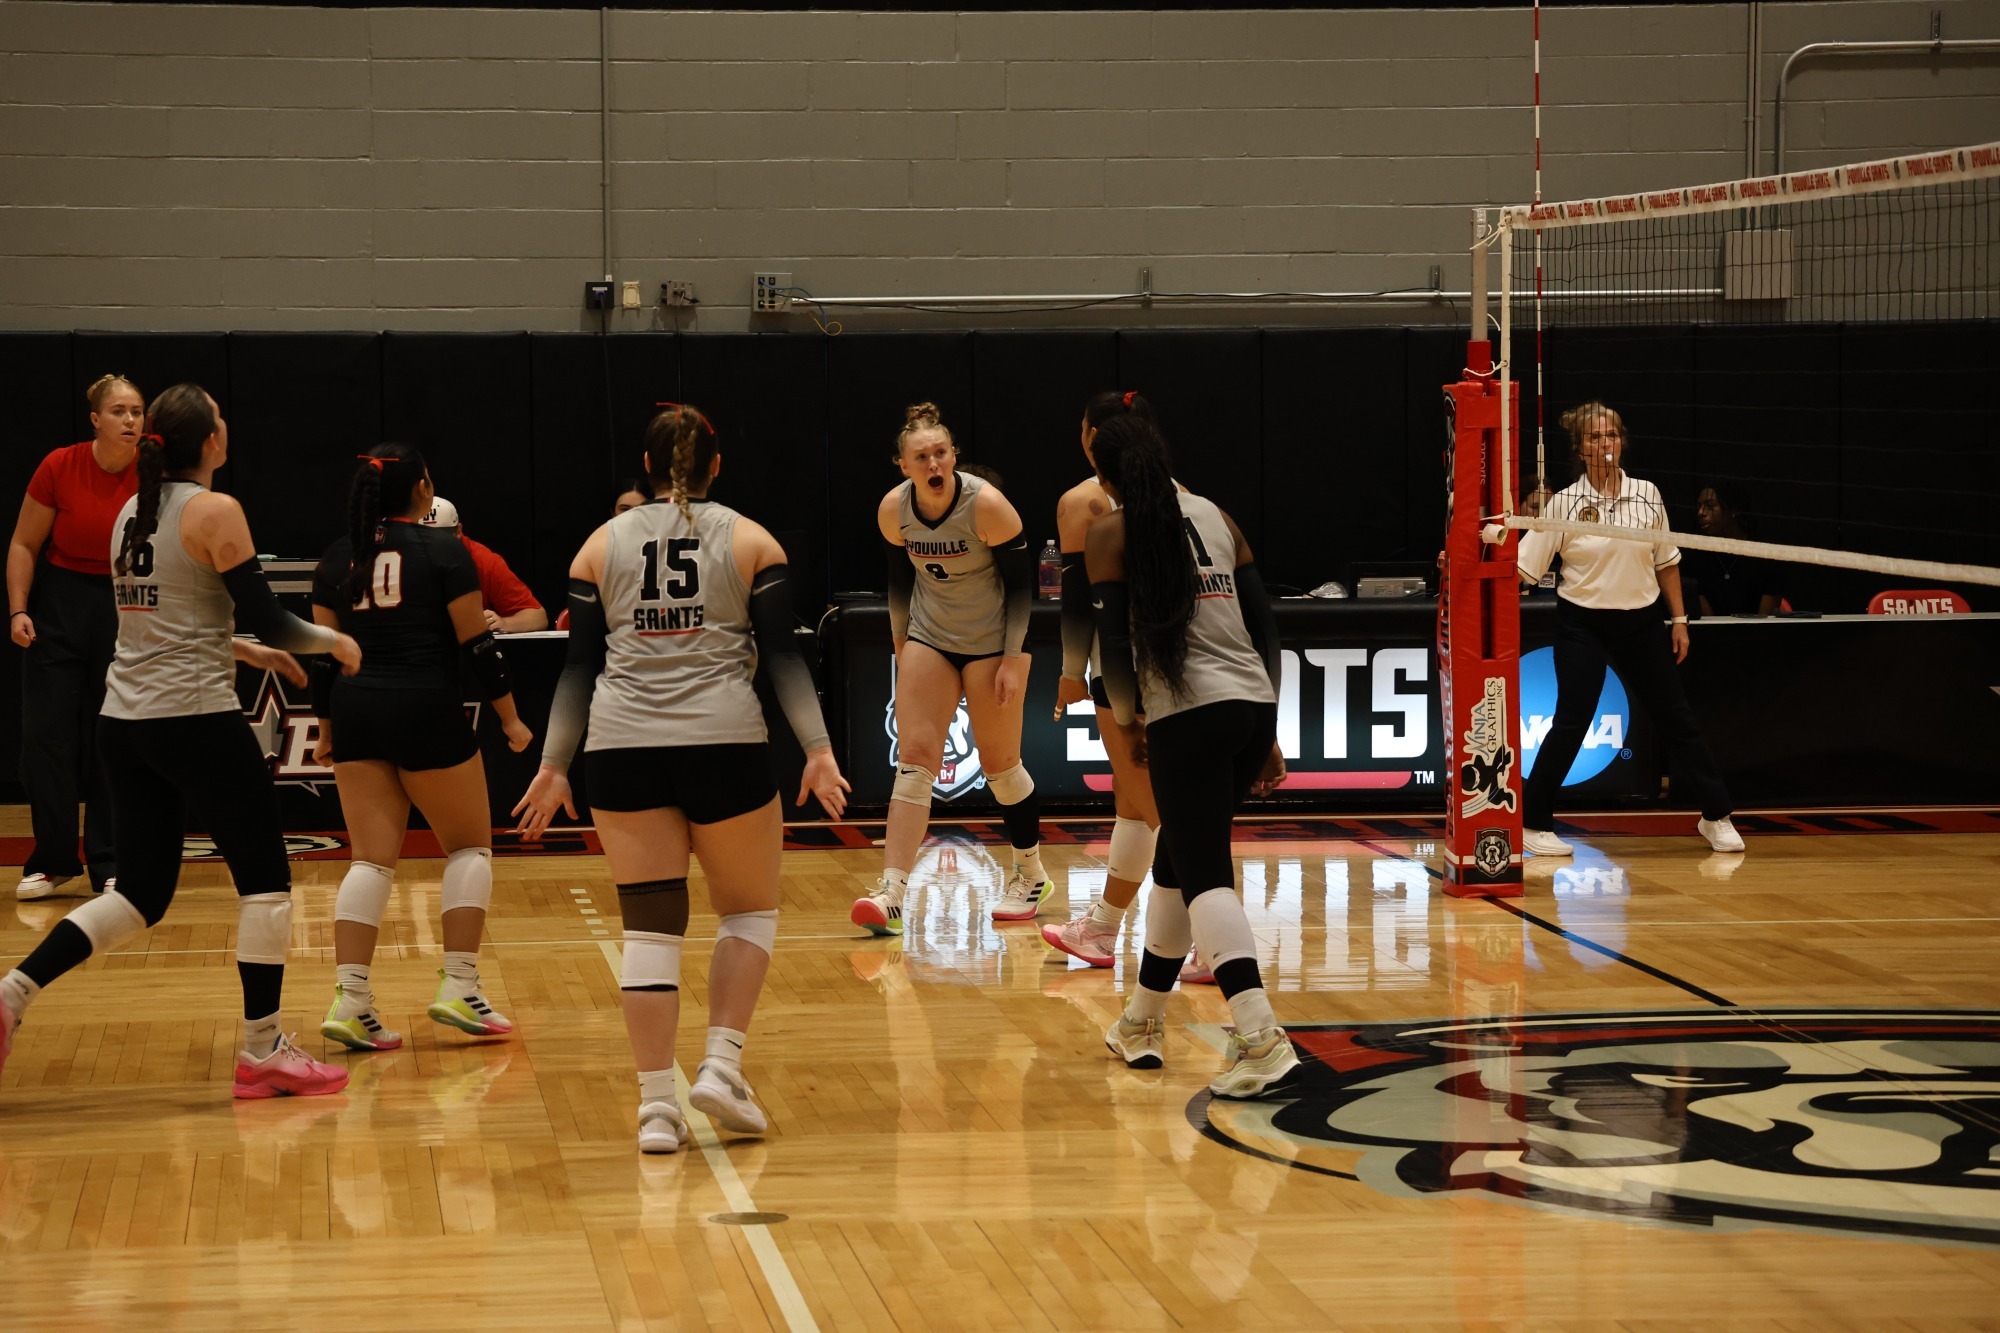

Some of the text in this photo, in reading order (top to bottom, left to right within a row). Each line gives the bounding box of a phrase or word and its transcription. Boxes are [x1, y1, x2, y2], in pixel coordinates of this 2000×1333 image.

[640, 537, 700, 600] 15
[1466, 702, 1489, 761] NINJA
[1486, 680, 1497, 754] GRAPHICS
